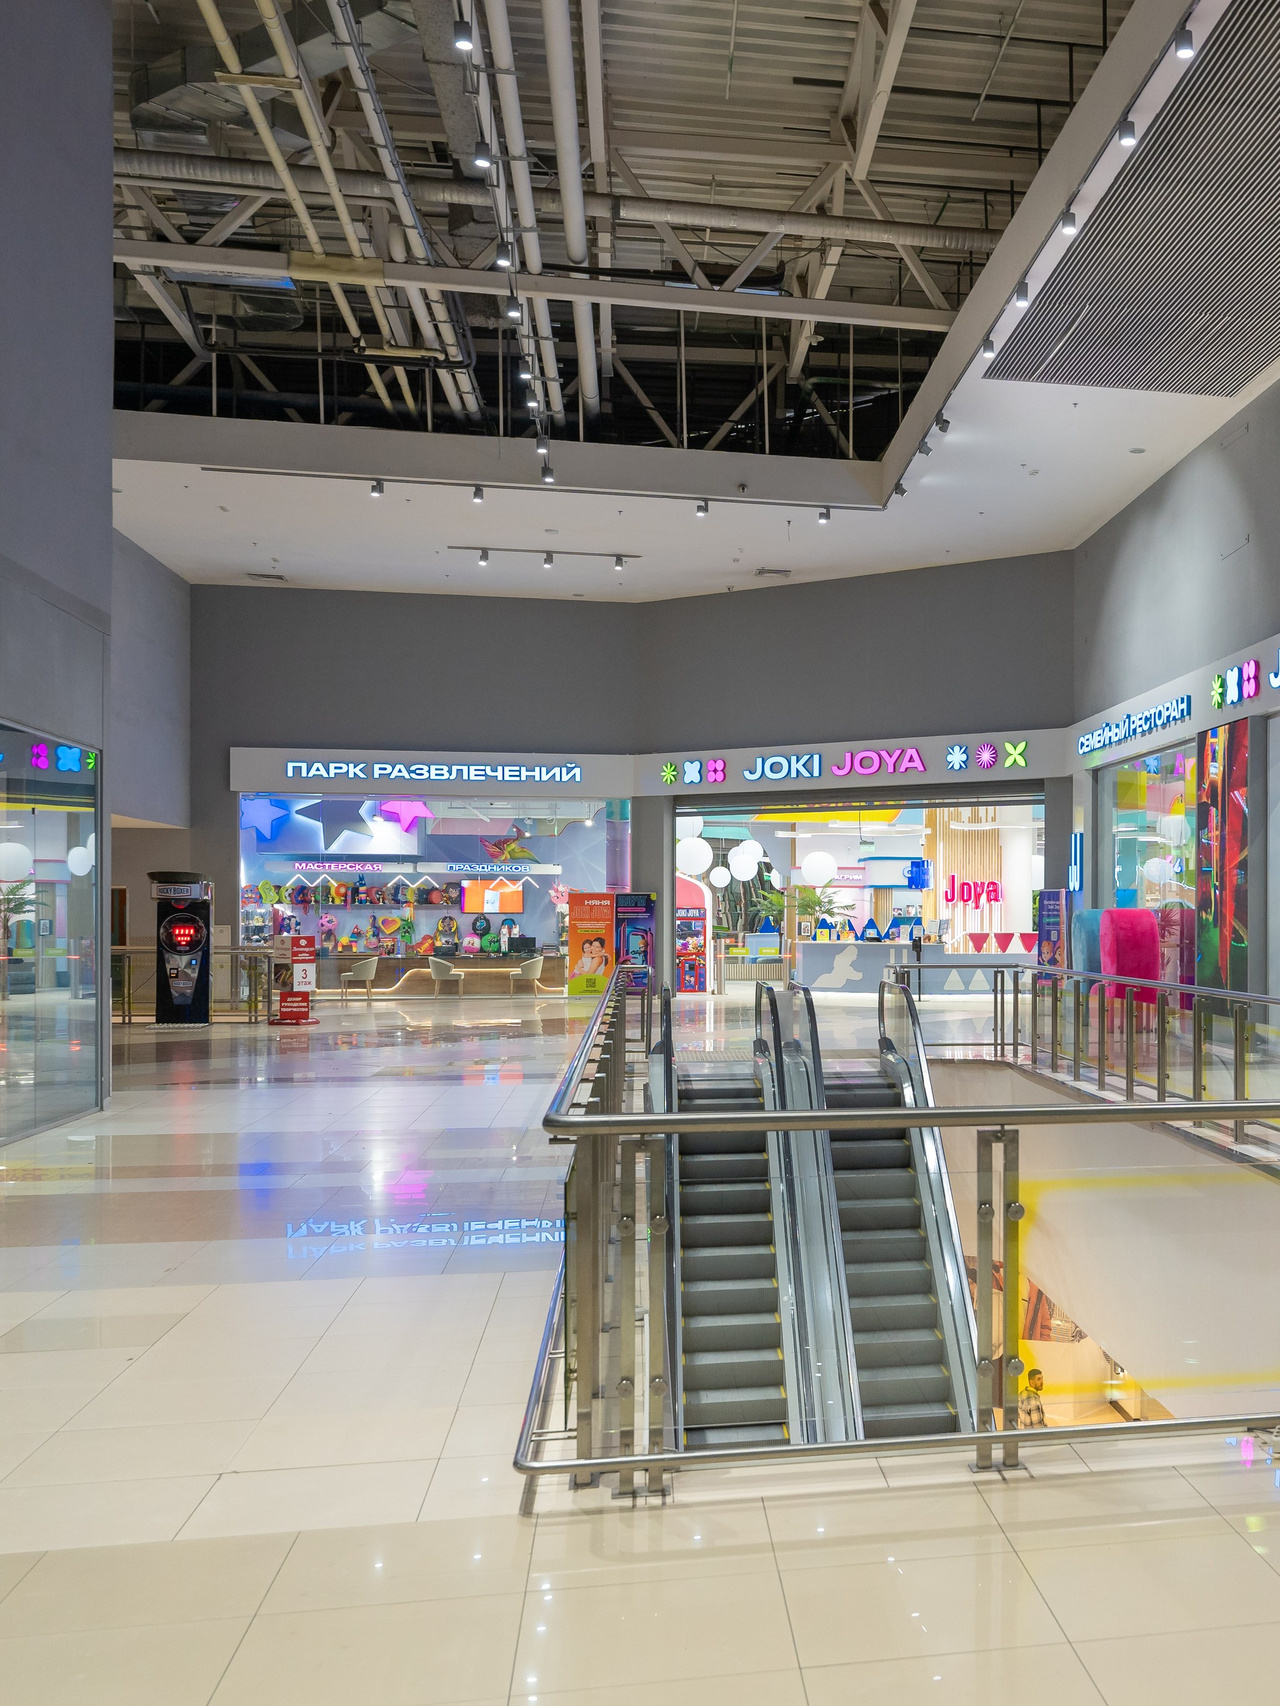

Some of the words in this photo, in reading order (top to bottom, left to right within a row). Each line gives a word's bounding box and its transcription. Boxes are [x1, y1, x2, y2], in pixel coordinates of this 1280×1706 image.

[1078, 714, 1131, 755] СЕМЕЙНЫЙ
[1130, 694, 1191, 736] РЕСТОРАН
[743, 753, 822, 781] JOKI
[831, 747, 927, 777] JOYA
[286, 761, 368, 780] ПАРК
[373, 760, 582, 783] РАЗВЛЕЧЕНИЙ
[294, 862, 383, 872] МАСТЕРСКАЯ
[447, 863, 531, 873] ПРАЗДНИКОВ
[944, 874, 1002, 911] Joya
[572, 906, 590, 918] JOKI
[676, 908, 687, 917] JOKI
[687, 908, 700, 917] JOYA
[301, 968, 308, 979] 3
